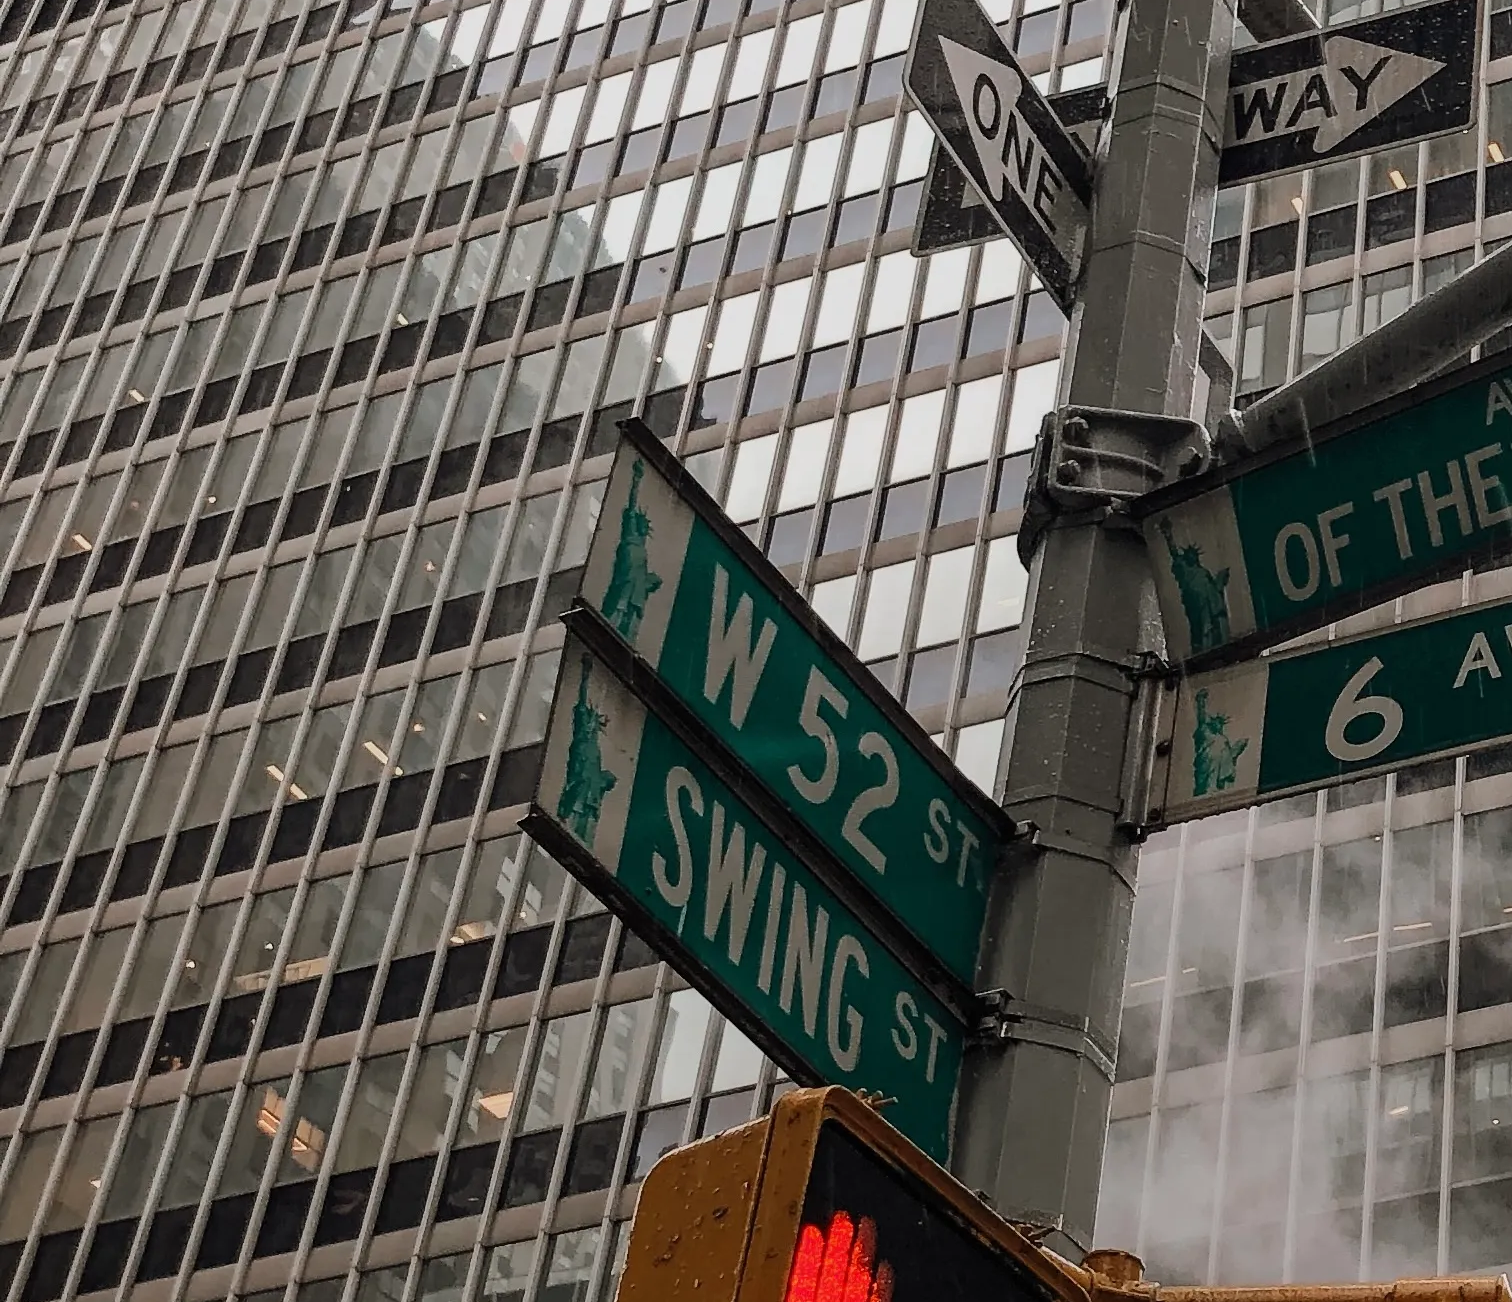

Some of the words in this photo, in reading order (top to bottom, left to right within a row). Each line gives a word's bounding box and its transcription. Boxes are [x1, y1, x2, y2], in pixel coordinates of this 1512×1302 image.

[972, 72, 1064, 236] ONE
[1232, 55, 1394, 141] WAY
[1274, 502, 1355, 602] OF
[703, 563, 778, 731] W
[786, 665, 900, 875] 52
[923, 798, 981, 890] ST
[1324, 655, 1404, 762] 6
[651, 765, 870, 1073] SWING
[890, 993, 948, 1084] ST
